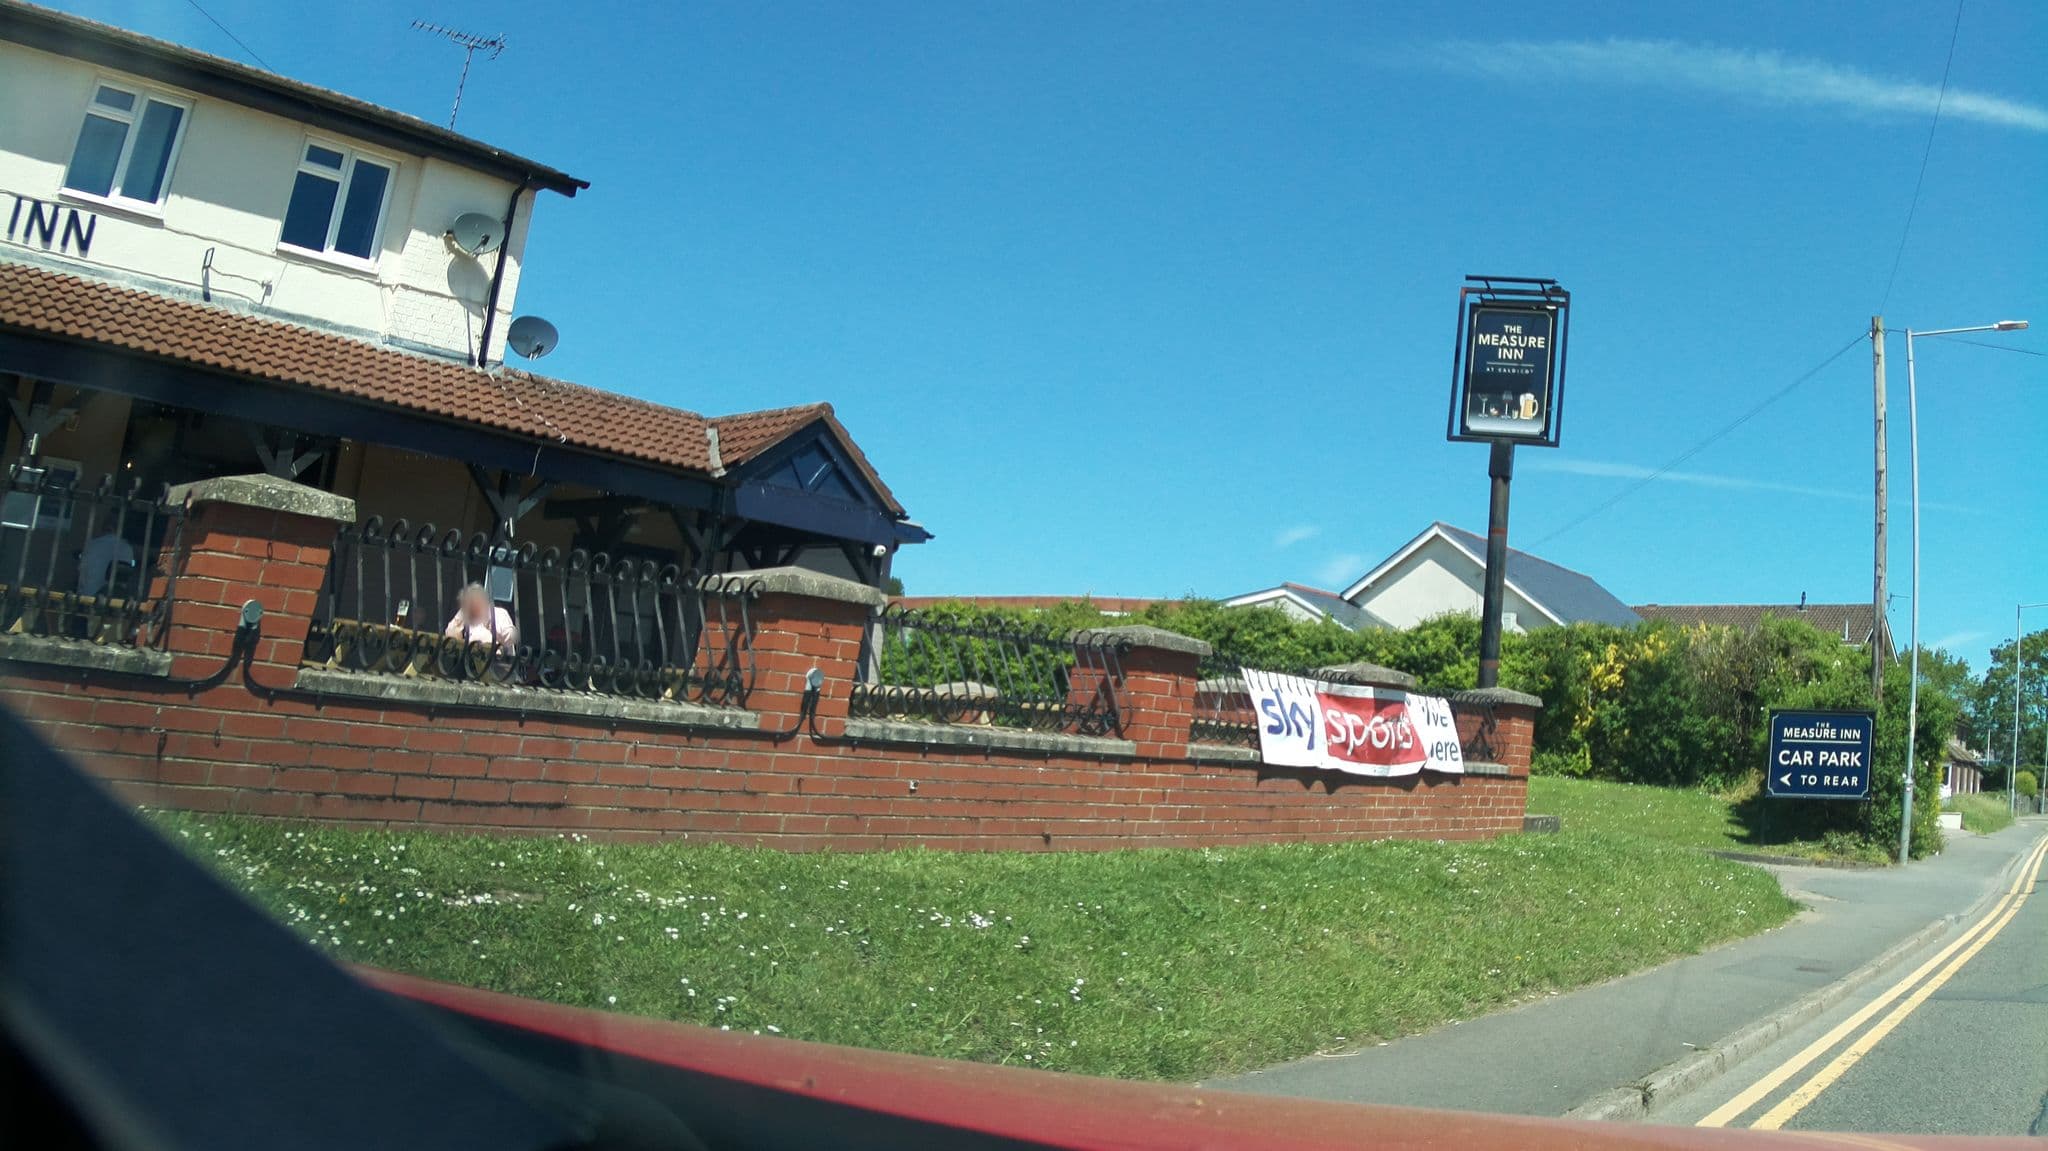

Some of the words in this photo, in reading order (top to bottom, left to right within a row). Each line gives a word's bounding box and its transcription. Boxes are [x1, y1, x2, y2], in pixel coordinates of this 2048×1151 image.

[7, 196, 97, 252] INN
[1504, 324, 1522, 334] THE
[1478, 333, 1546, 349] MEASURE
[1498, 348, 1524, 360] INN
[1260, 688, 1315, 751] sky
[1783, 727, 1837, 740] MEASURE
[1840, 728, 1861, 740] INN
[1778, 749, 1814, 766] CAR
[1819, 750, 1862, 767] PARK
[1800, 774, 1818, 786] TO
[1823, 775, 1859, 787] REAR
